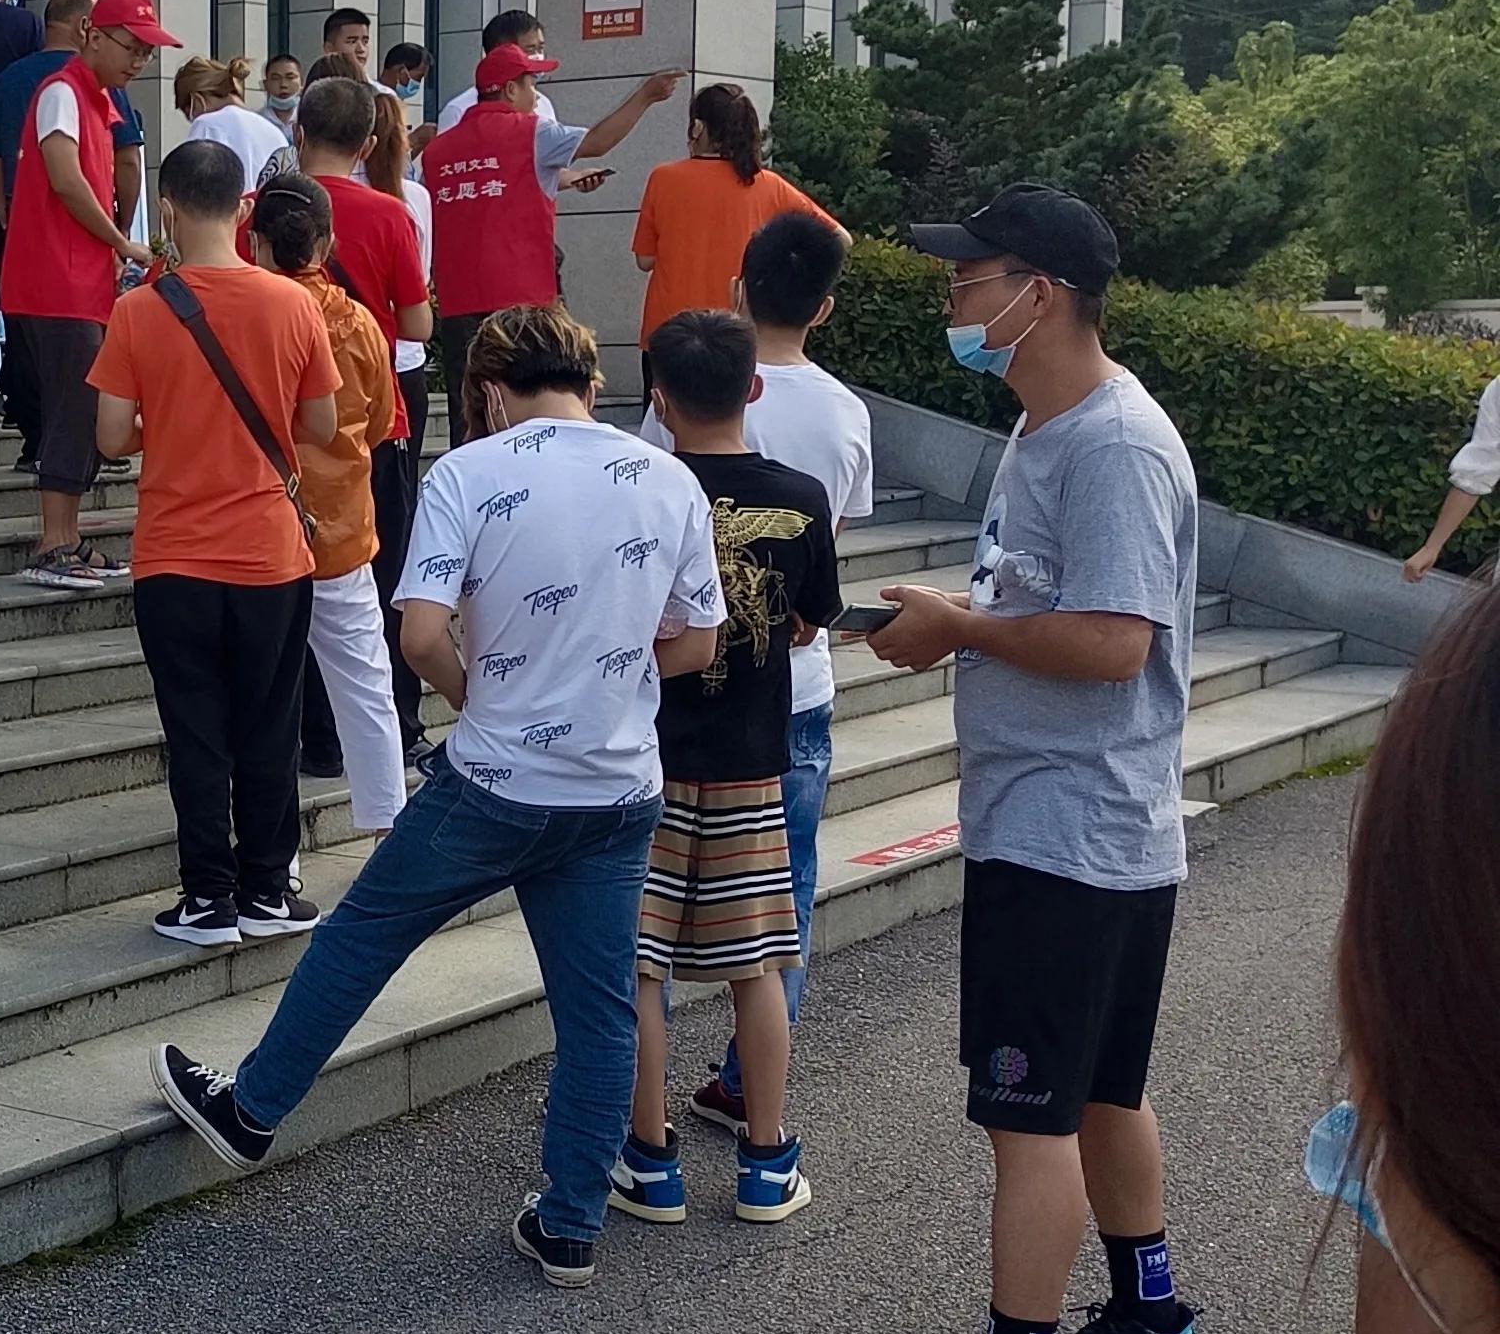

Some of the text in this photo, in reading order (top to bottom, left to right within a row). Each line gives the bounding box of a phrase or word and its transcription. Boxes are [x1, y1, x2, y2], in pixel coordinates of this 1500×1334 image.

[440, 157, 500, 177] 文明交通
[436, 180, 508, 205] 志愿者
